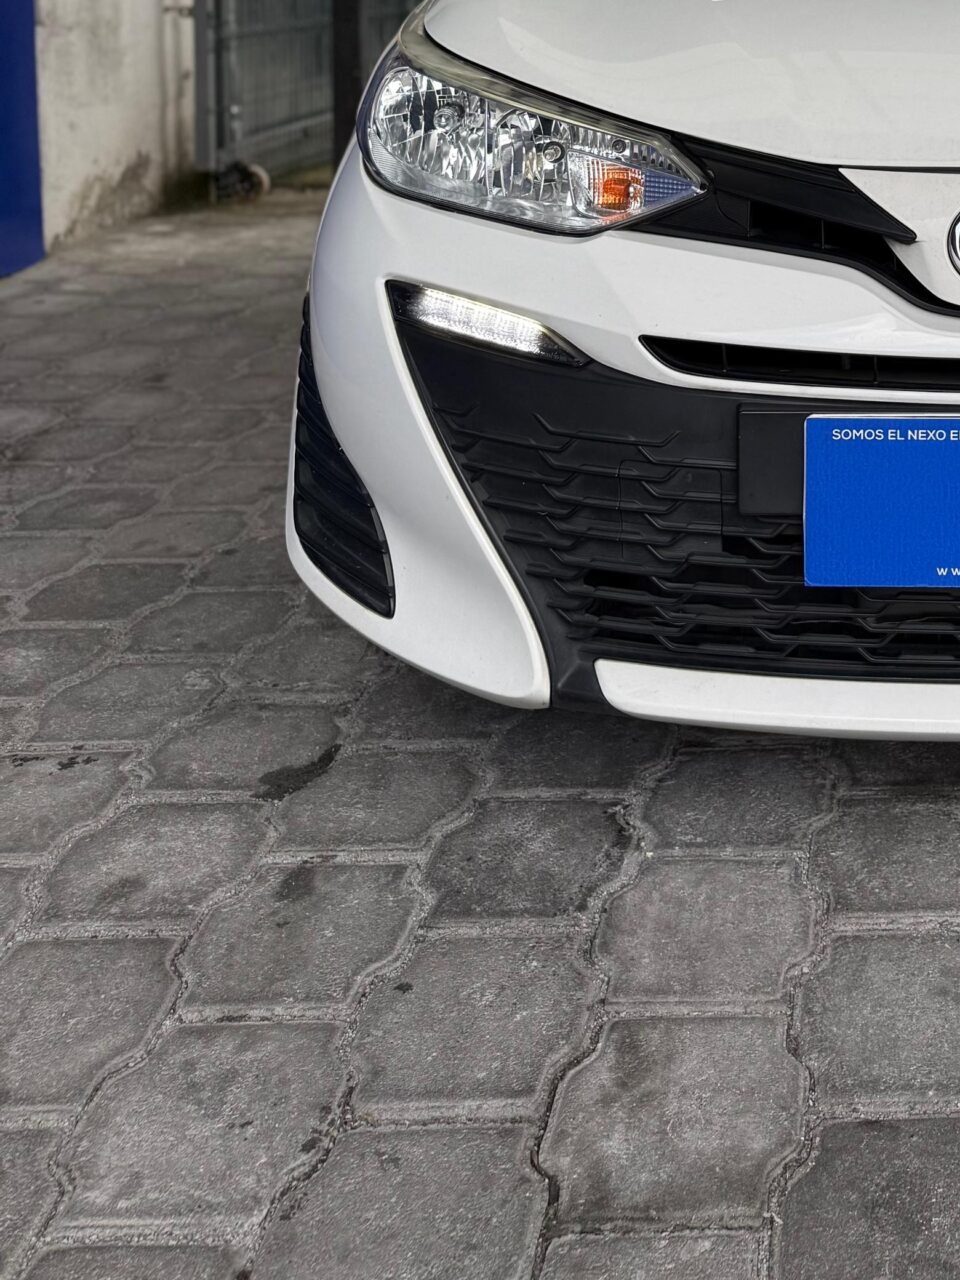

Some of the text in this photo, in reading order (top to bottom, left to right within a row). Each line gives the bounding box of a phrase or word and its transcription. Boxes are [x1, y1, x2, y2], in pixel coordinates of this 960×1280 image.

[832, 428, 884, 441] SOMOS
[887, 428, 905, 441] EL
[907, 429, 947, 441] NEXO
